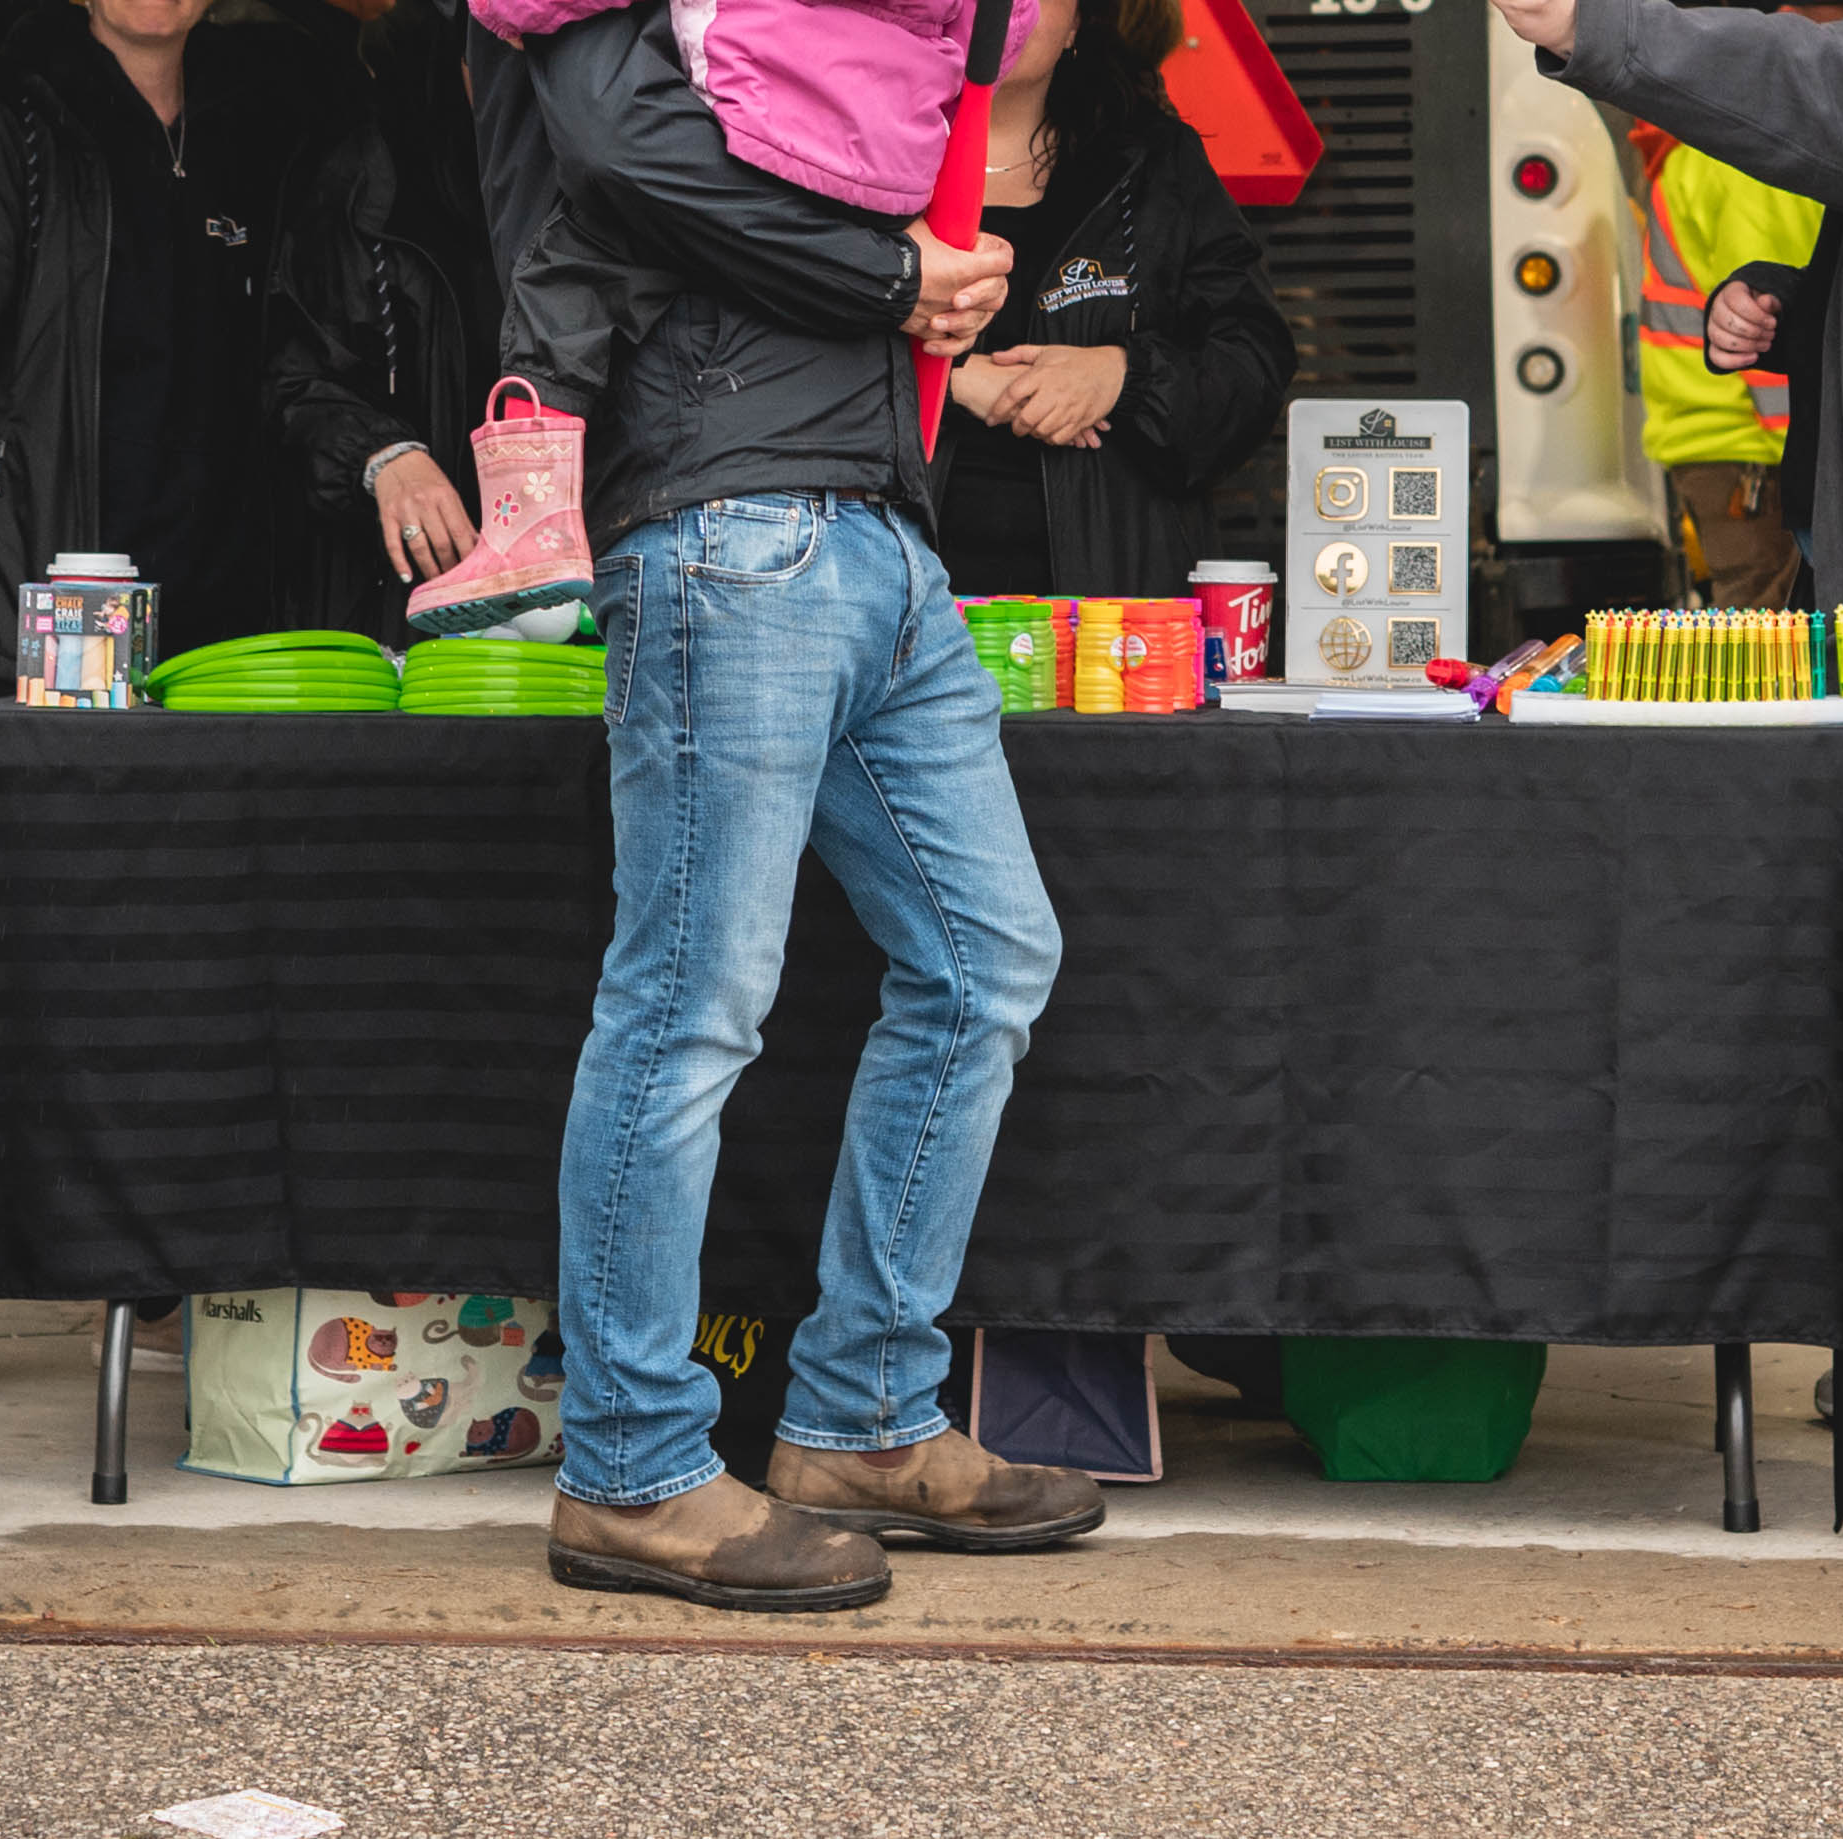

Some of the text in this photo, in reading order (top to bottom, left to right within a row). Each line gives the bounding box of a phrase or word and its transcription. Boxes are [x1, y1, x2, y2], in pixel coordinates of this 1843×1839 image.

[1043, 279, 1127, 305] LIST WITH LOUISE
[1329, 437, 1426, 449] LIST WITH LOUISE
[200, 1296, 264, 1323] Marshalls
